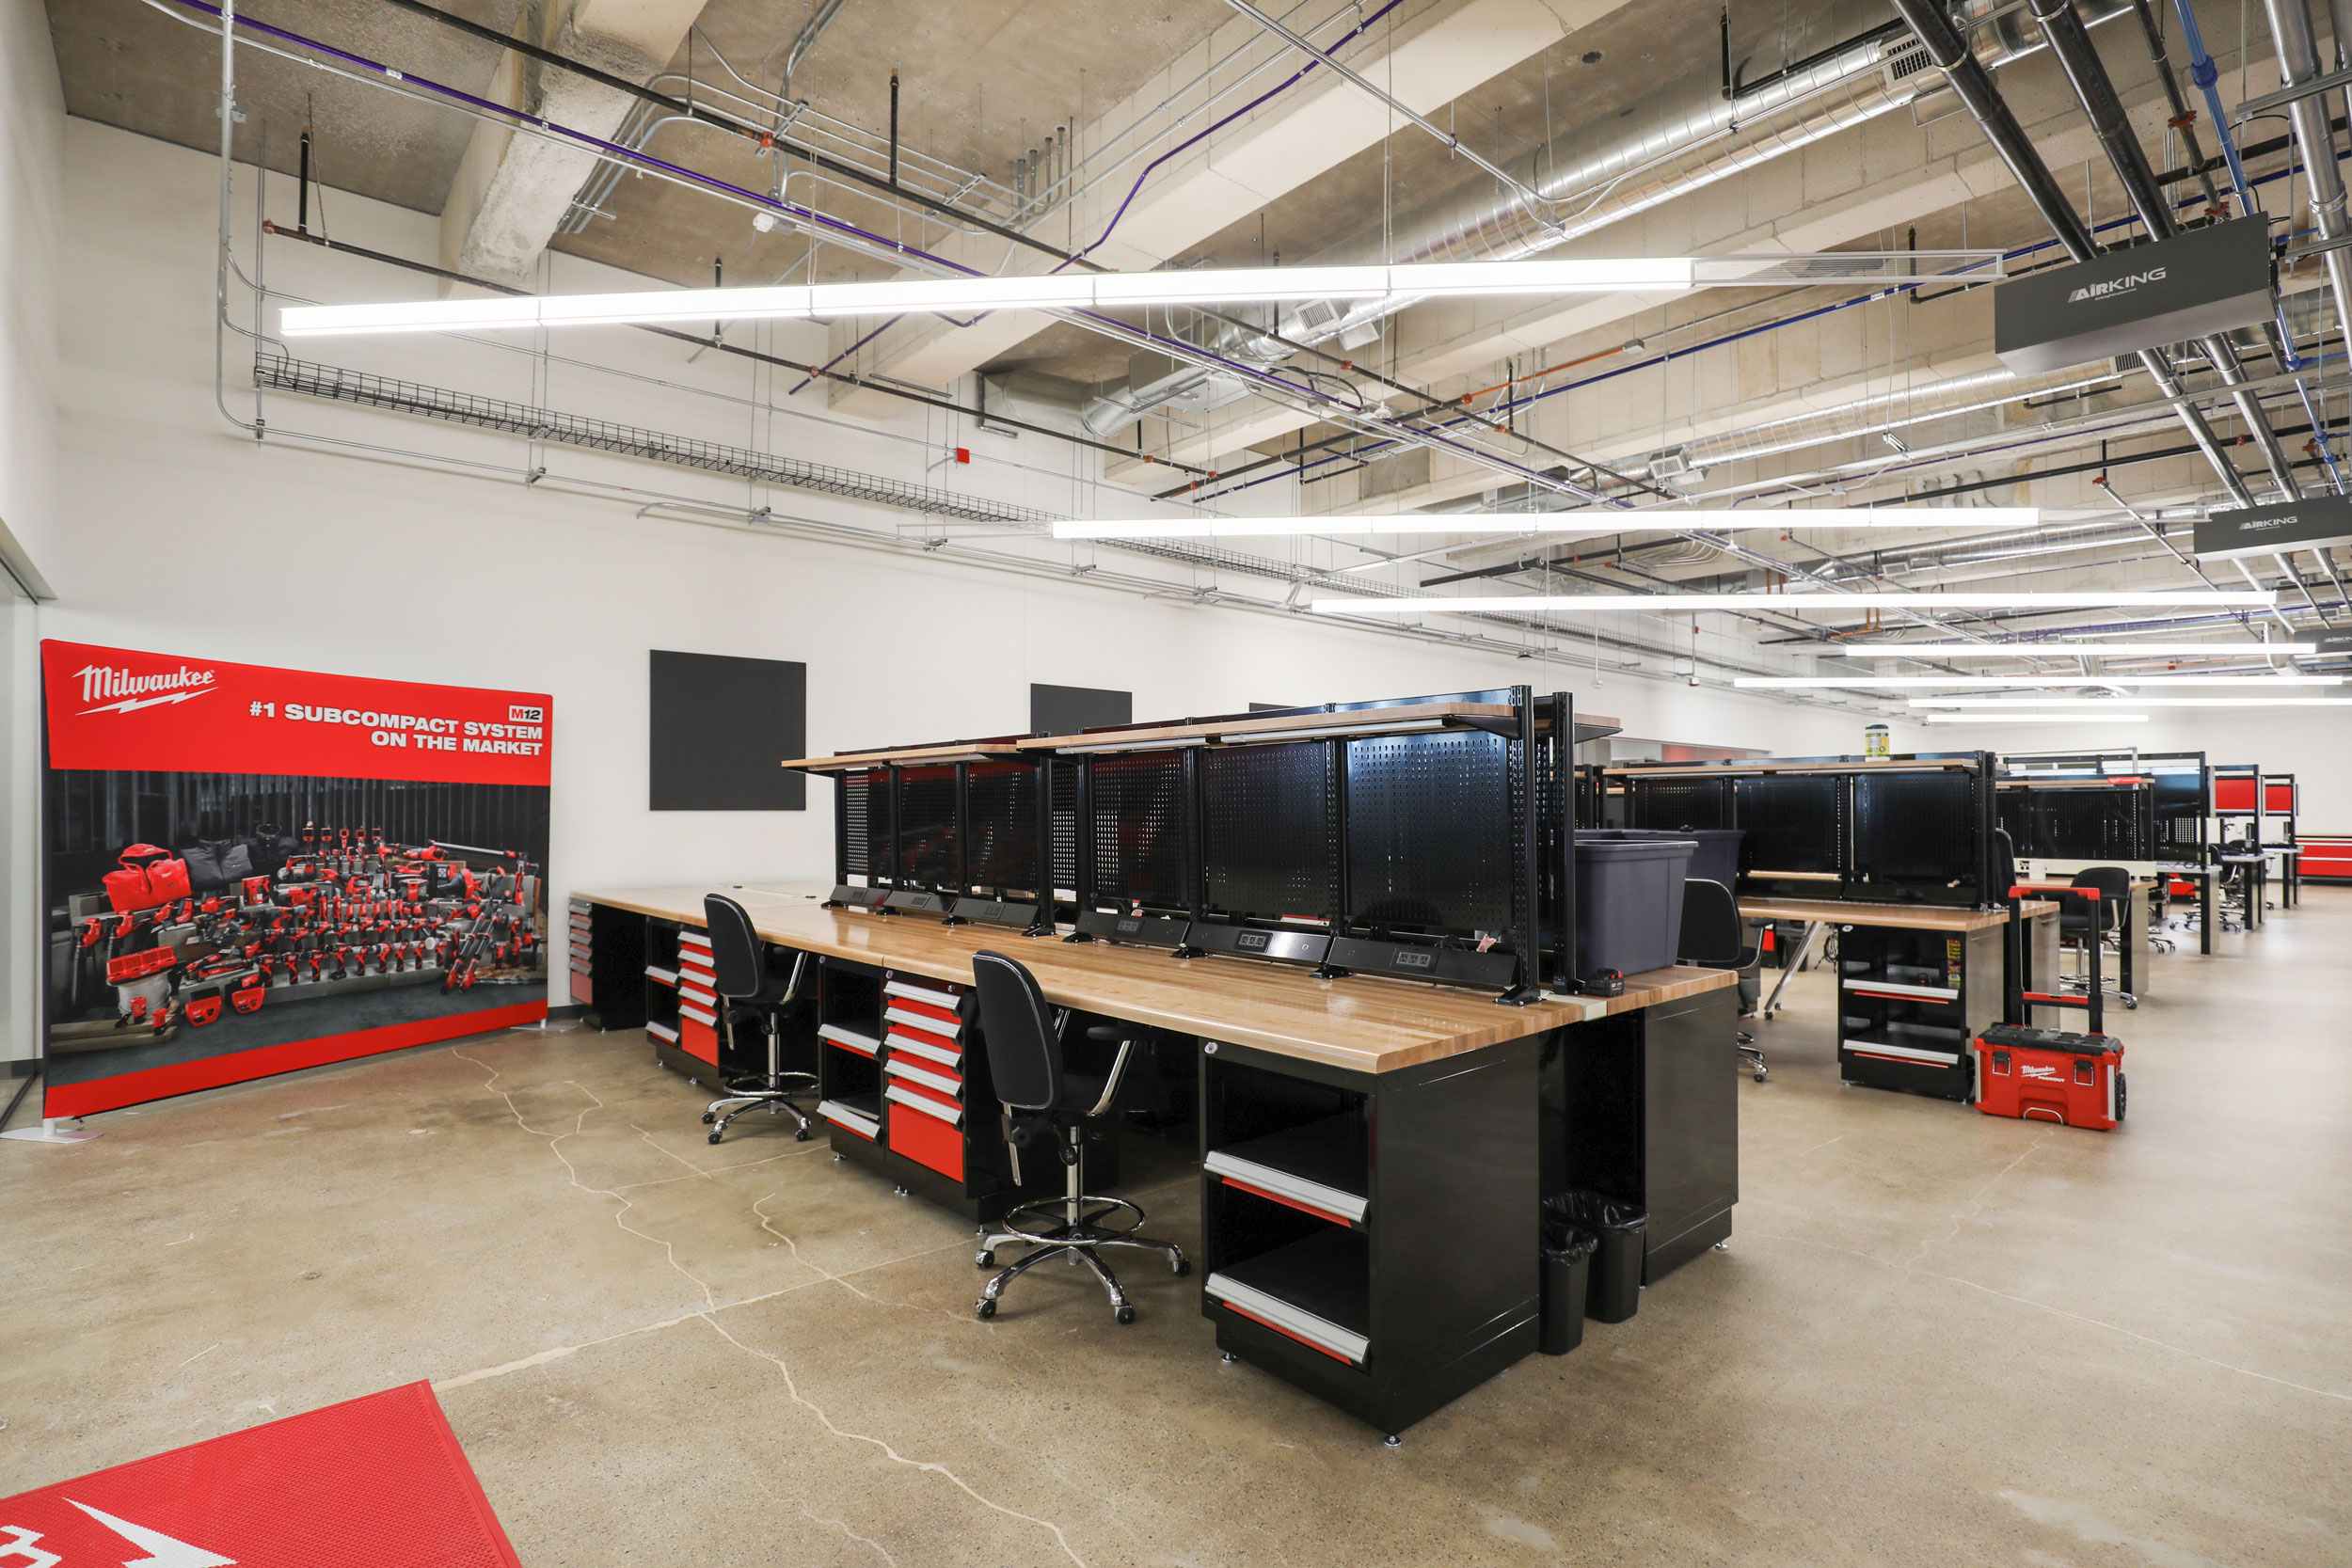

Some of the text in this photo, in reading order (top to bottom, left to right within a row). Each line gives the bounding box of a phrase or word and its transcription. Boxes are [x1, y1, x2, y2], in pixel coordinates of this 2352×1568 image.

[72, 664, 215, 703] Milwaukee
[249, 701, 543, 740] #1 SUBCOMPACT SYSTEM
[511, 707, 542, 721] M12
[371, 731, 543, 756] ON THE MARKET
